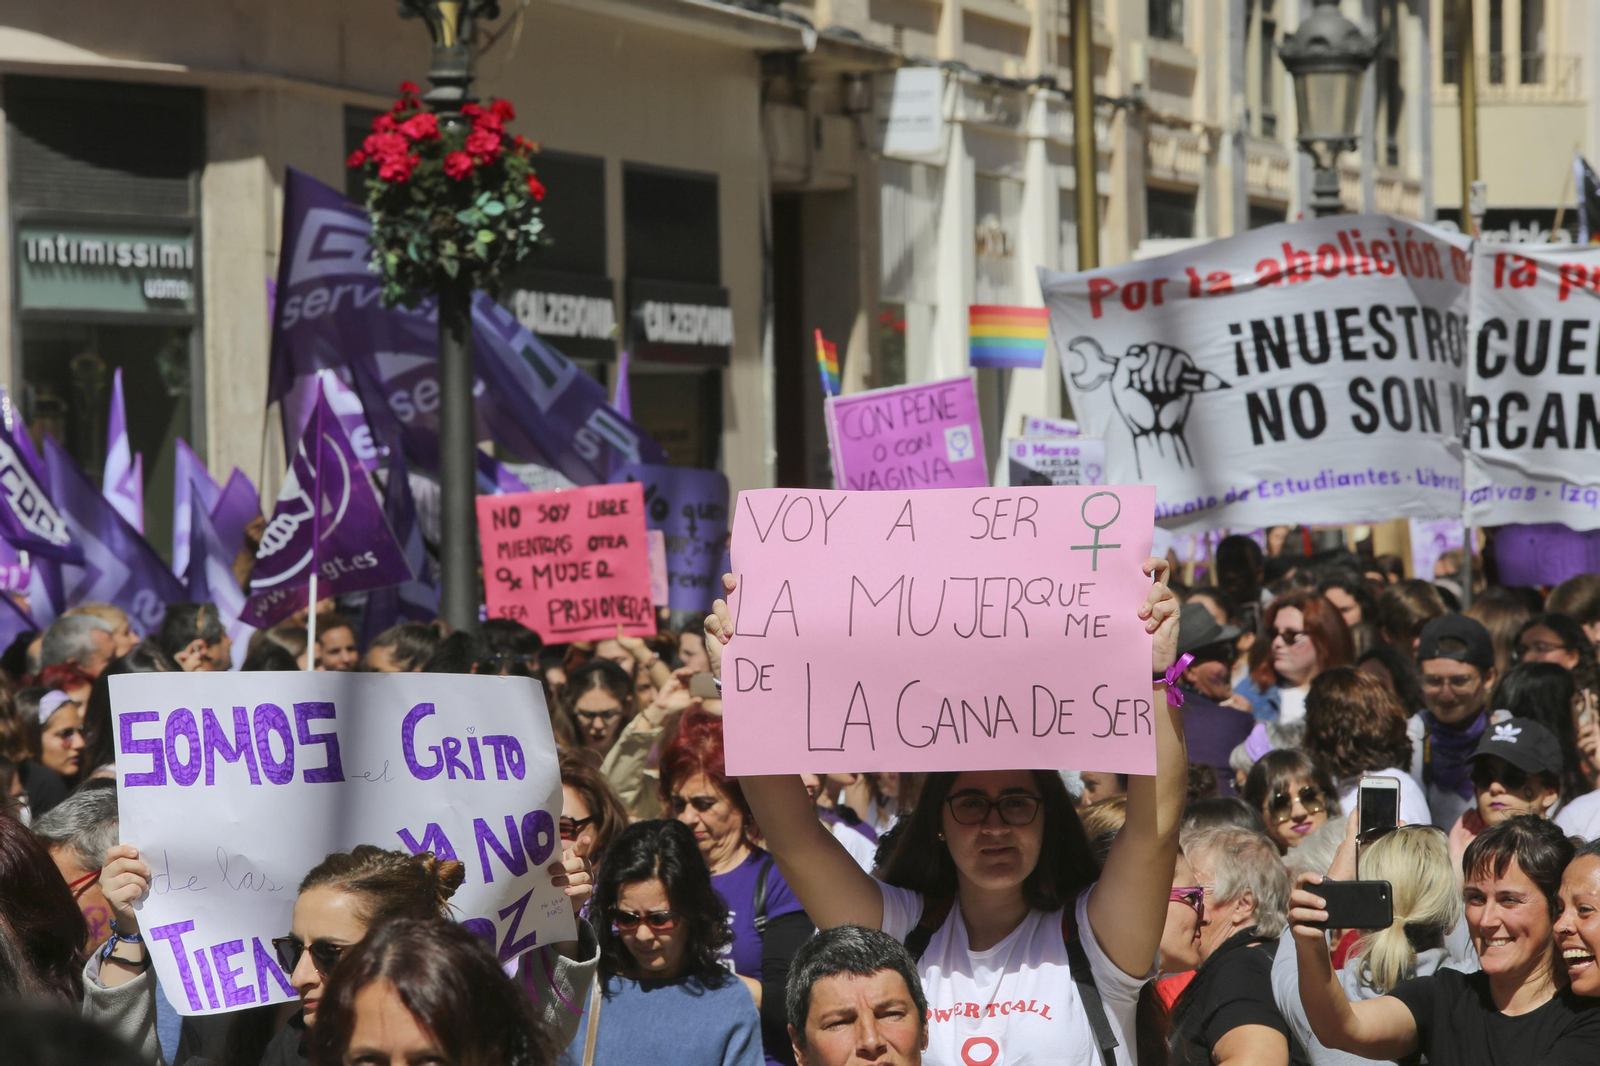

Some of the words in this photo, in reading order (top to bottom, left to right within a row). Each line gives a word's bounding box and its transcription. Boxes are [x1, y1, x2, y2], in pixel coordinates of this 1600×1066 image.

[27, 234, 194, 269] intimissimi
[1088, 277, 1169, 319] Por
[1185, 267, 1234, 298] la
[1255, 228, 1444, 286] abolición
[1494, 252, 1538, 289] la
[1476, 317, 1600, 379] CUE
[841, 401, 894, 441] CON
[901, 387, 957, 428] PENE
[1246, 382, 1327, 446] NO
[1348, 375, 1443, 435] SON
[849, 457, 955, 489] VAGINA
[872, 443, 888, 463] O
[894, 431, 932, 457] CON
[1225, 486, 1250, 505] de
[1257, 467, 1401, 499] Estudiantes
[491, 506, 521, 530] NO
[537, 503, 570, 523] SOY
[587, 499, 629, 520] LIBRE
[745, 493, 848, 545] VOY
[886, 498, 916, 542] A
[970, 495, 1039, 541] SER
[497, 534, 574, 560] MIENTRAS
[587, 534, 628, 552] OTRA
[532, 560, 615, 590] MUJER
[498, 605, 529, 621] SEA
[548, 594, 653, 627] PRISIONERA
[734, 574, 799, 638] LA
[848, 574, 1029, 639] MUJER
[1024, 577, 1096, 607] QUE
[1065, 613, 1111, 639] ME
[735, 657, 775, 693] DE
[806, 662, 875, 752] LA
[896, 679, 1019, 749] GANA
[1032, 684, 1076, 738] DE
[1092, 684, 1152, 738] SER
[119, 701, 346, 787] SOMOS
[352, 759, 395, 782] el
[149, 849, 207, 895] de
[217, 846, 284, 894] las
[473, 809, 556, 885] NO
[150, 919, 300, 1012] TIEN
